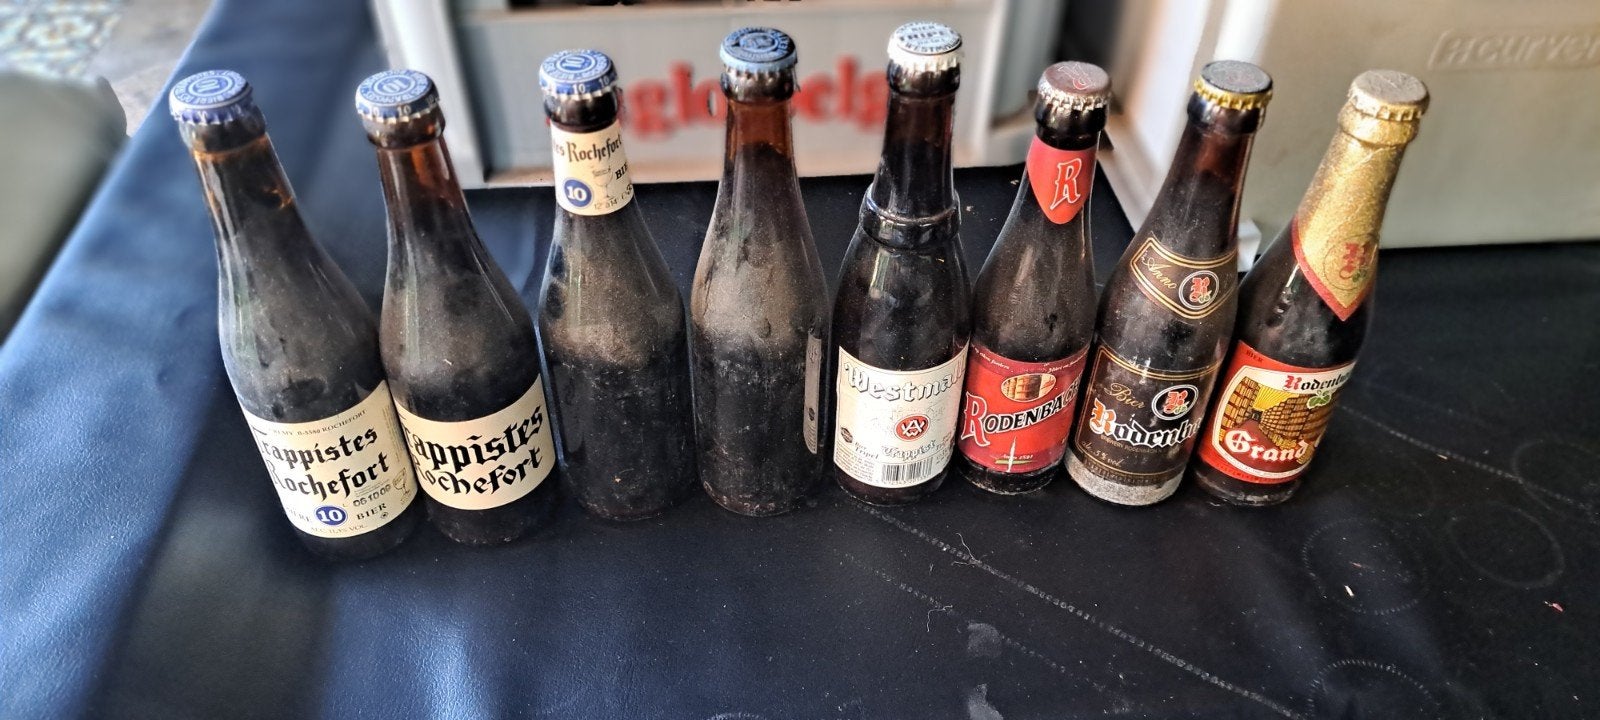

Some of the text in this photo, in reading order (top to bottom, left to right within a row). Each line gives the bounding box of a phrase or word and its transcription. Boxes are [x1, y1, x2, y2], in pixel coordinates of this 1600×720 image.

[573, 84, 586, 95] 10
[566, 185, 588, 202] 10
[1049, 157, 1082, 211] R
[1104, 382, 1146, 410] Bier
[321, 408, 368, 433] ROCHEFORT
[251, 426, 378, 472] Trappistes
[1224, 429, 1308, 462] Grand
[264, 452, 390, 502] Rochefort
[315, 509, 344, 523] 10
[355, 501, 389, 522] BIER
